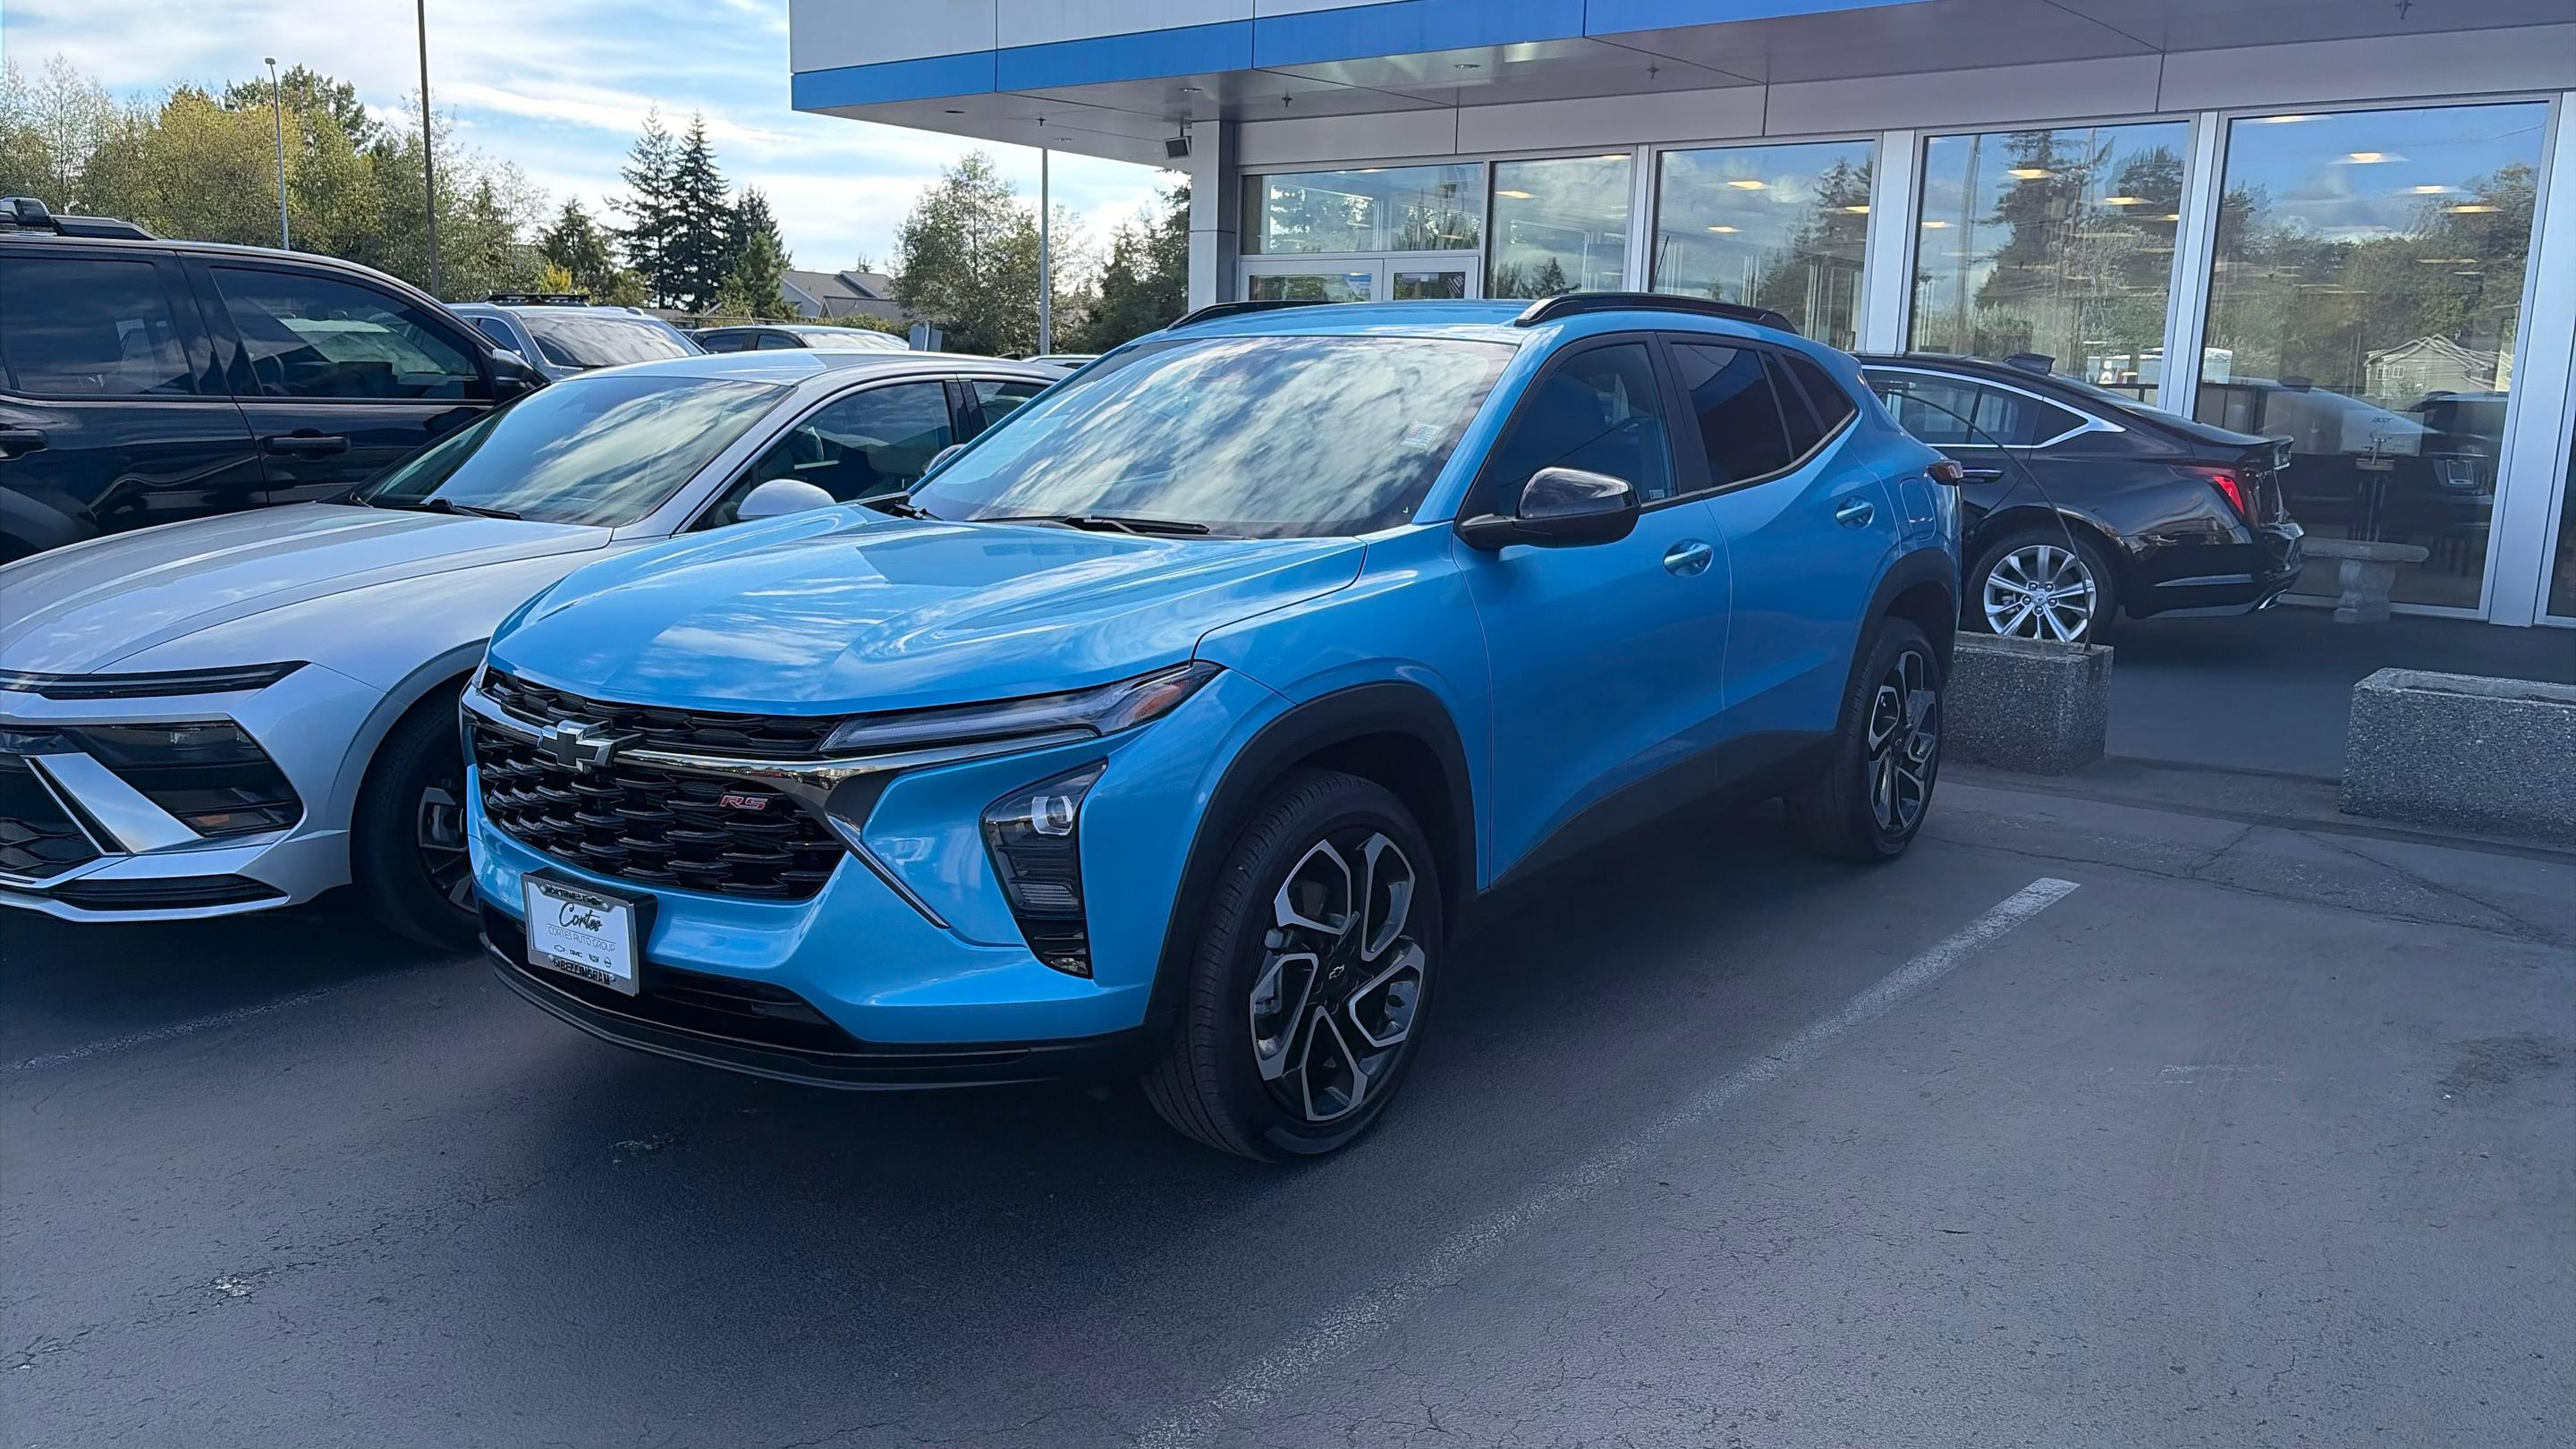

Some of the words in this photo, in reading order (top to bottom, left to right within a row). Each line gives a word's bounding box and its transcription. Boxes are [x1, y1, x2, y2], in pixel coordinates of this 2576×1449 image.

[720, 795, 768, 810] RS
[546, 886, 587, 902] NORTHWEST
[559, 902, 603, 931] Cortes
[549, 927, 572, 940] CORTES
[573, 934, 591, 946] AUTO
[593, 939, 615, 952] GROUP
[561, 961, 610, 985] BELLINGHAM
